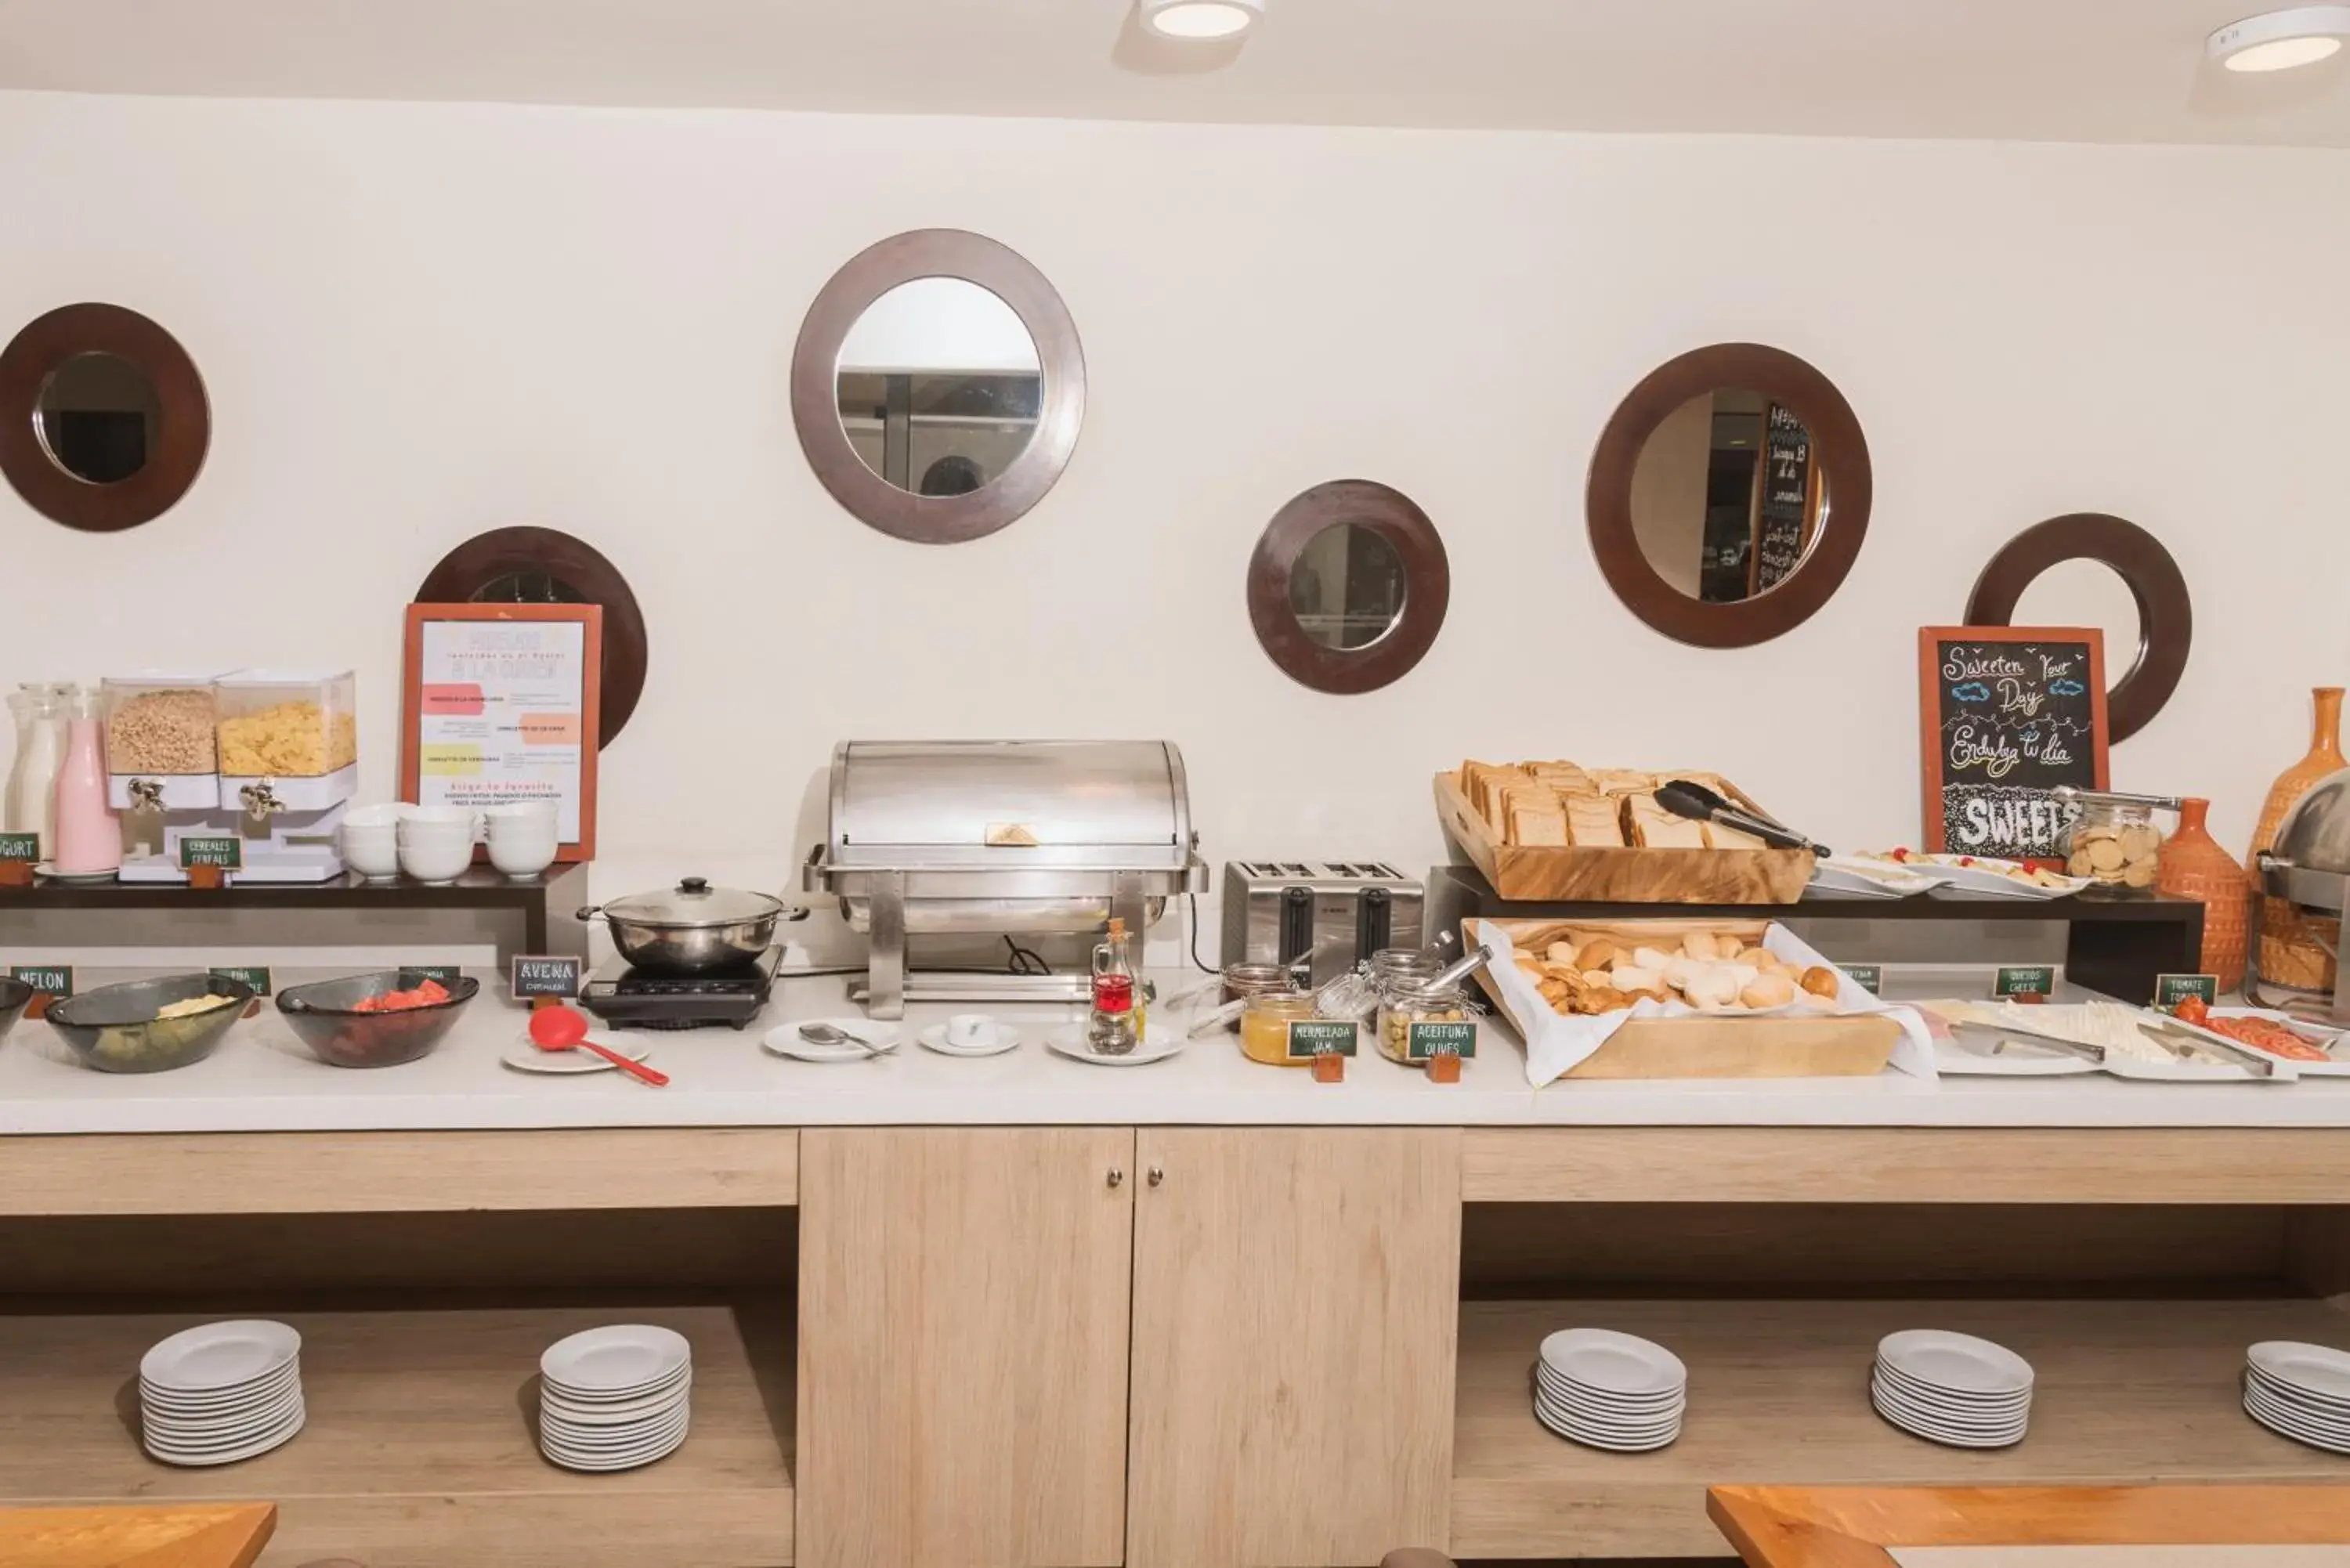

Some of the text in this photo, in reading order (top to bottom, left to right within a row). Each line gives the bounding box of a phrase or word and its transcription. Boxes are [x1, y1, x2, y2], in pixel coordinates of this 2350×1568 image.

[1943, 646, 2072, 681] Sweeten Your
[1998, 677, 2045, 716] Day
[1959, 797, 2084, 846] SWEETS
[520, 963, 573, 979] AVENA
[20, 972, 64, 990] MELON
[1295, 1026, 1351, 1039] MERMELADA
[1416, 1024, 1470, 1039] ACEITUNA
[1312, 1041, 1334, 1053] JAM
[1424, 1042, 1460, 1056] OLIVES
